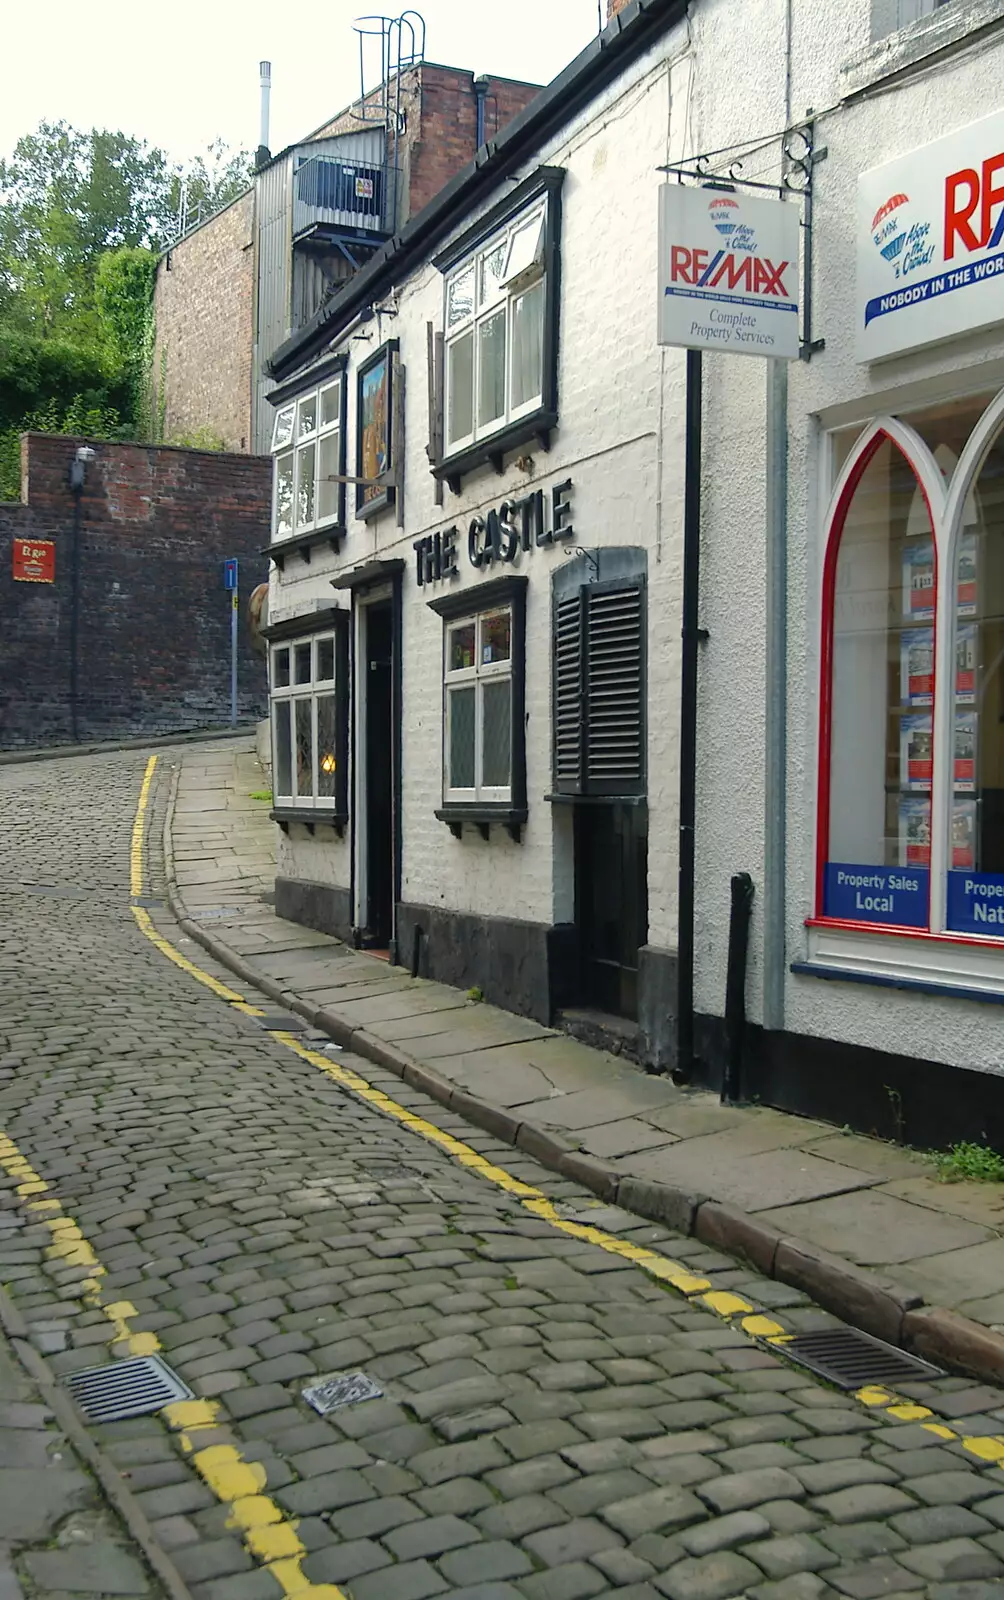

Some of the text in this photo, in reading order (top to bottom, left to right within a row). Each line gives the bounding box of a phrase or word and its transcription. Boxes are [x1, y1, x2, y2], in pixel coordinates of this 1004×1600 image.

[905, 222, 931, 246] Above
[902, 244, 936, 275] Crowd!
[911, 240, 925, 256] the
[671, 245, 789, 296] RE/MAX
[879, 285, 929, 311] NOBODY
[931, 279, 945, 294] IN
[947, 269, 971, 287] THE
[709, 308, 757, 328] Complete
[690, 321, 775, 345] Property Services
[413, 478, 573, 586] THE CASTLE
[837, 871, 919, 892] Property Sales
[964, 879, 1004, 898] Prope
[856, 892, 894, 912] Local
